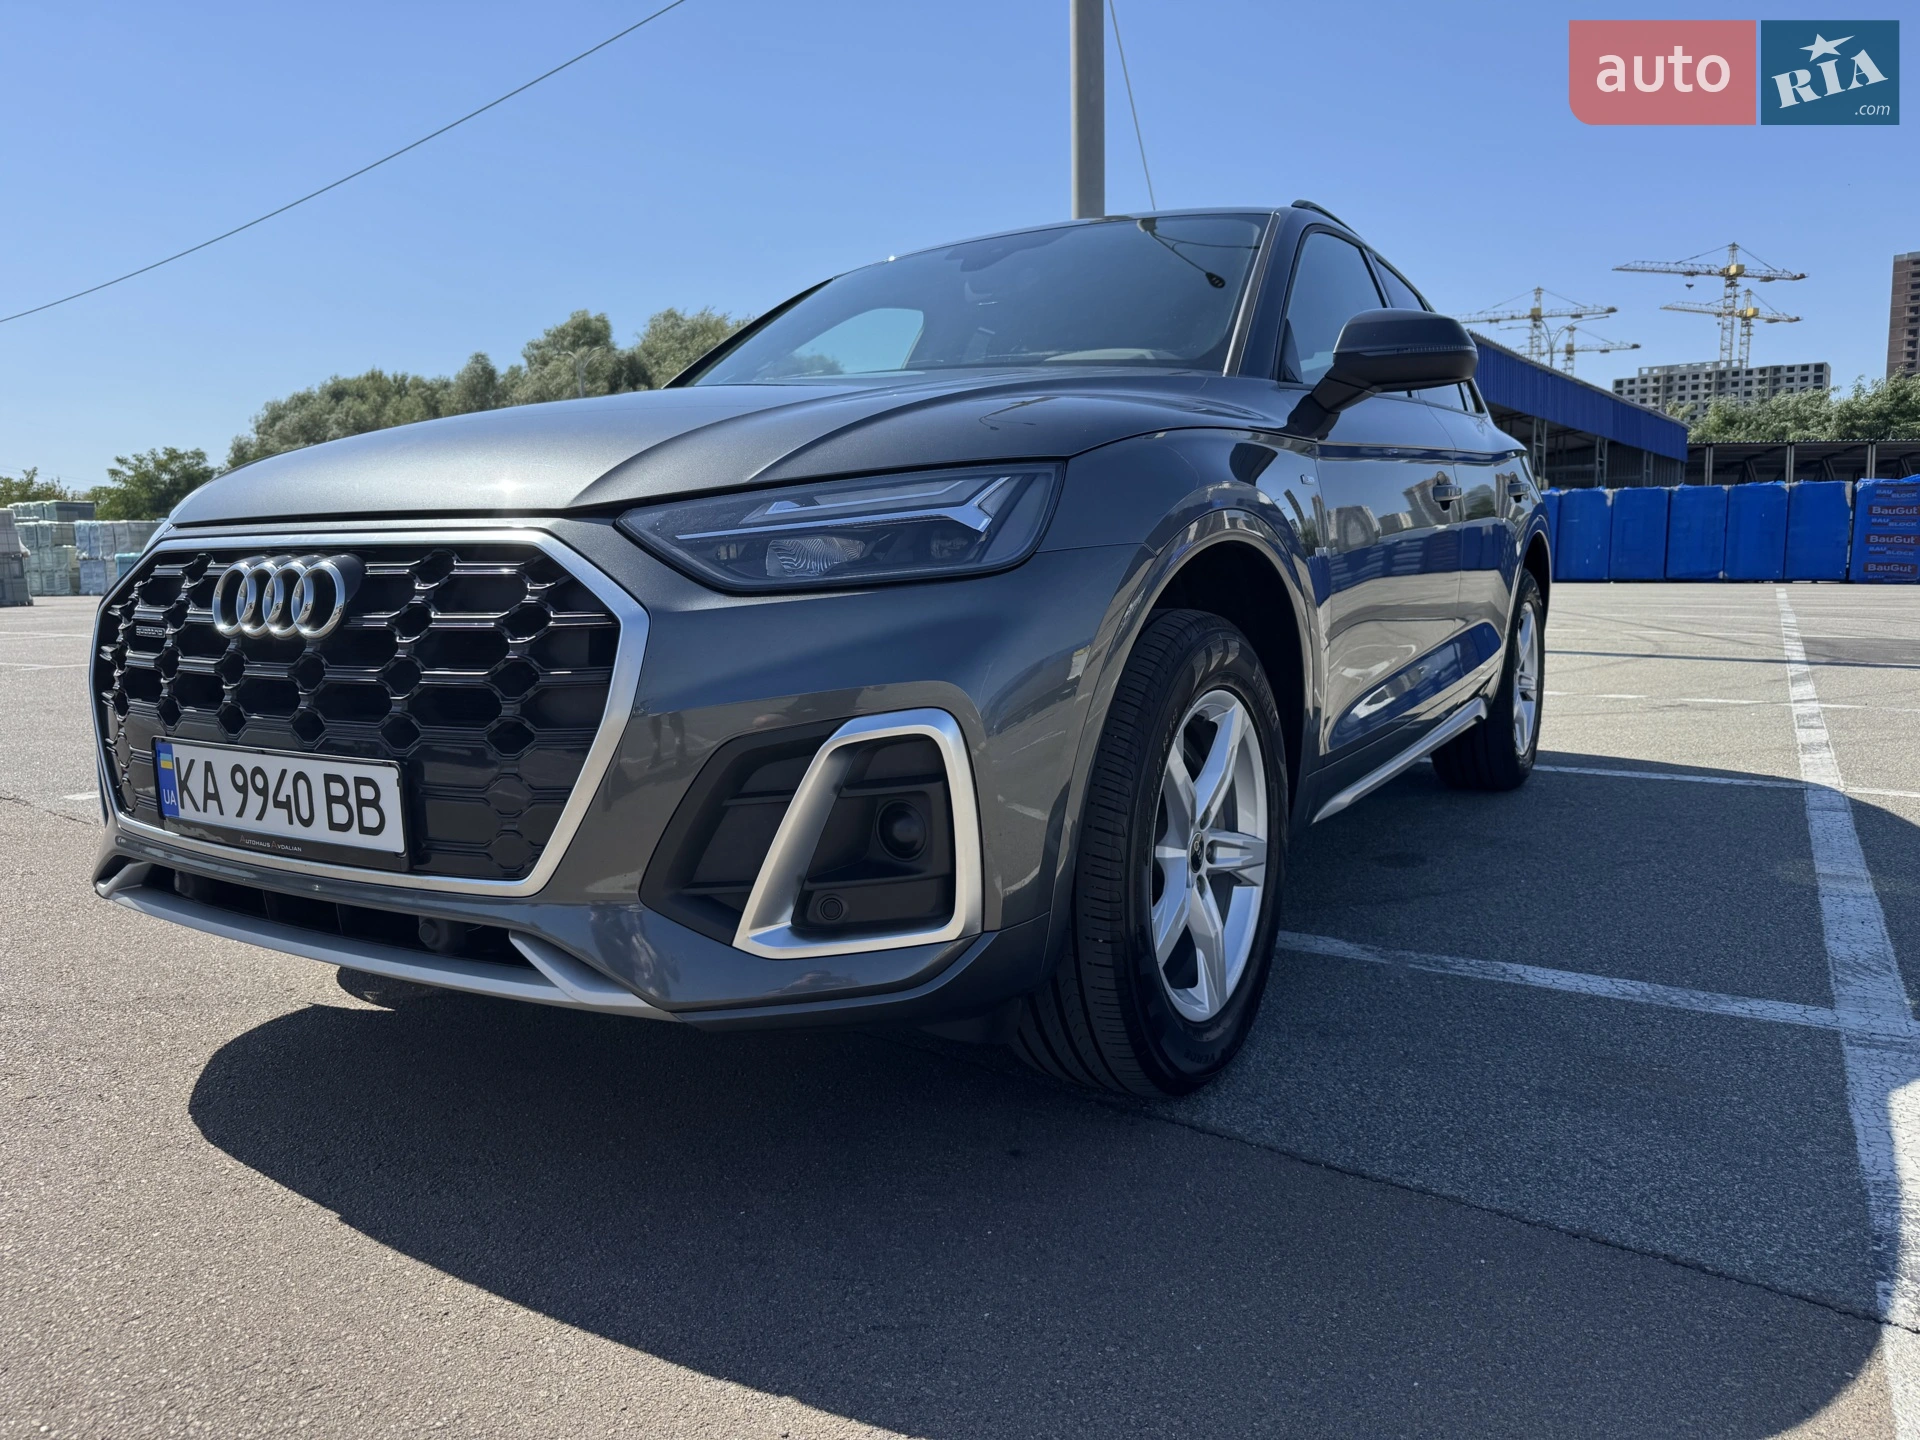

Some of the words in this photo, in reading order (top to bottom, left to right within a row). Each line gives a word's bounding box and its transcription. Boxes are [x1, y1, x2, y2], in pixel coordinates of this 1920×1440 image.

[1872, 506, 1918, 515] BauGut
[1869, 535, 1916, 544] BauGut
[1867, 563, 1913, 573] BauGut
[163, 788, 177, 806] UA
[175, 756, 225, 816] KA
[230, 763, 315, 829] 9940
[323, 773, 386, 837] BB
